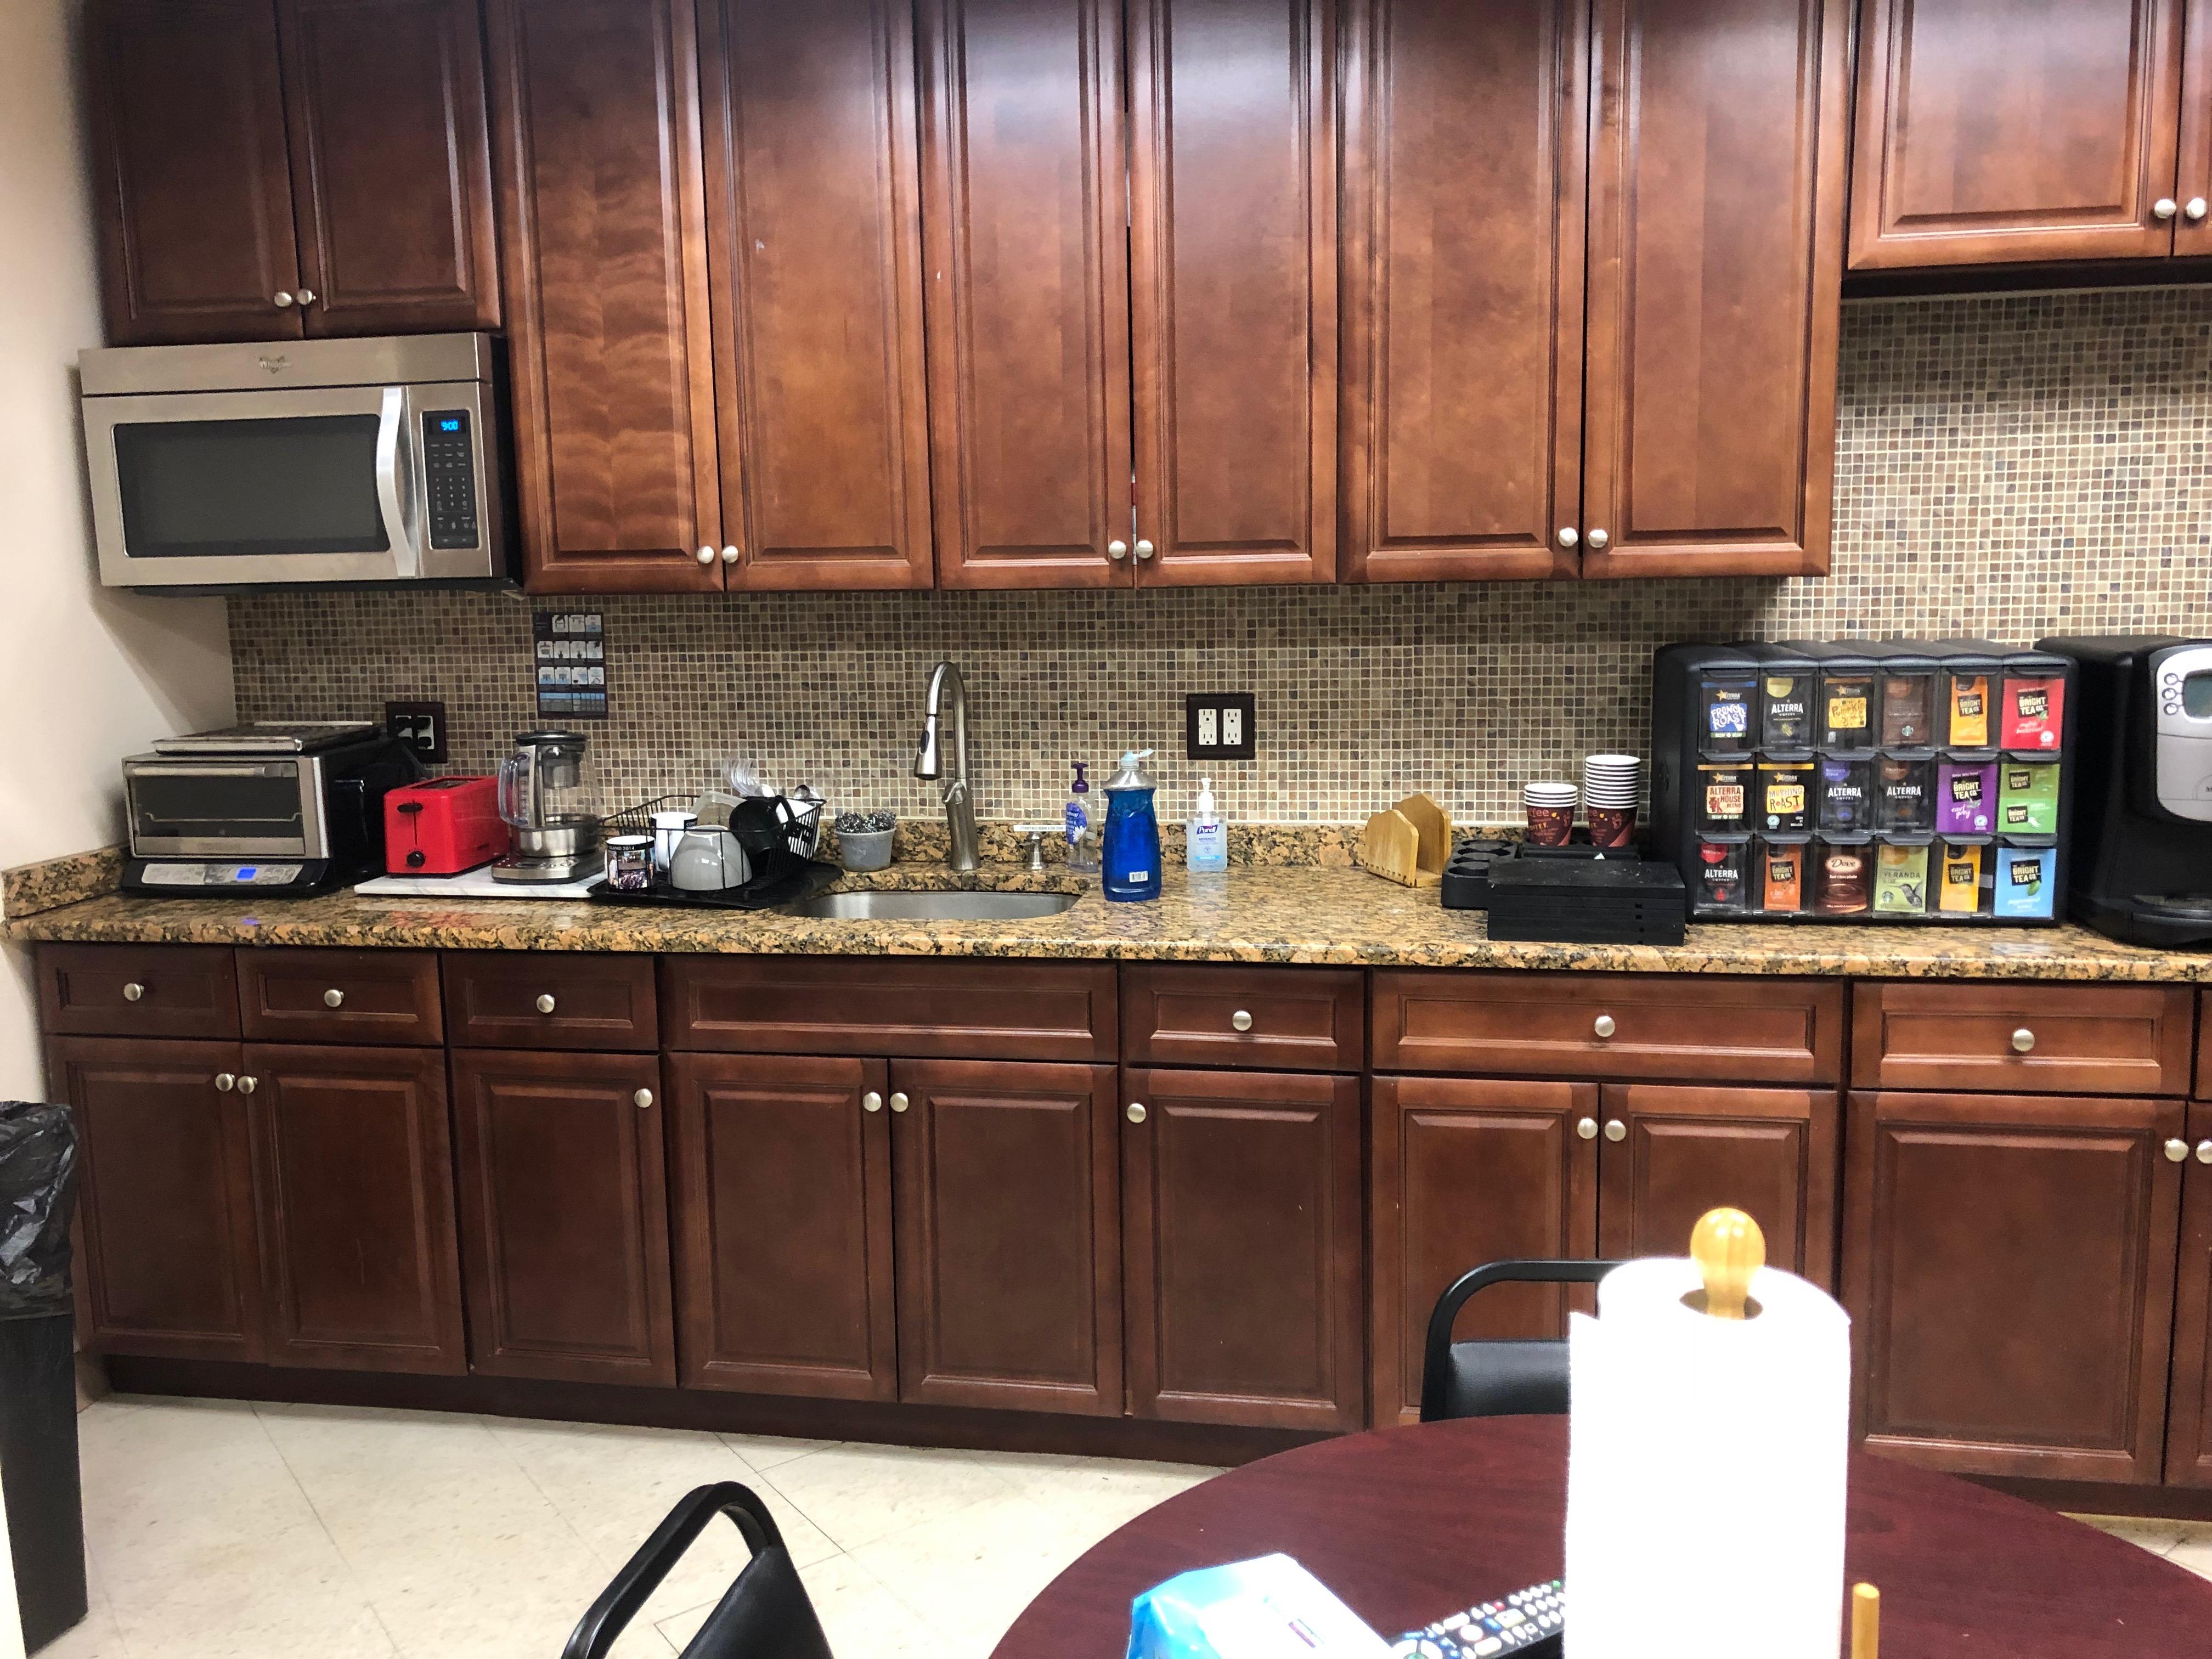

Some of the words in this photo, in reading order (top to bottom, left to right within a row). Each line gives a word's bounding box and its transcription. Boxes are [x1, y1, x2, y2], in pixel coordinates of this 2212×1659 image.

[2019, 697, 2046, 707] BRIGHT
[1771, 703, 1804, 714] ALTERRA
[2021, 706, 2036, 715] TEA
[1712, 714, 1746, 731] ROAST
[1710, 787, 1741, 795] ALTERRA
[1886, 786, 1921, 797] ALTERRA
[1953, 782, 1979, 792] BRIGHT
[1828, 787, 1862, 798] ALTERRA
[1955, 791, 1970, 799] TEA
[1831, 859, 1856, 868] Dove
[1705, 868, 1738, 879] ALTERRA
[2012, 866, 2039, 876] BRIGHT
[2014, 874, 2028, 883] TEA
